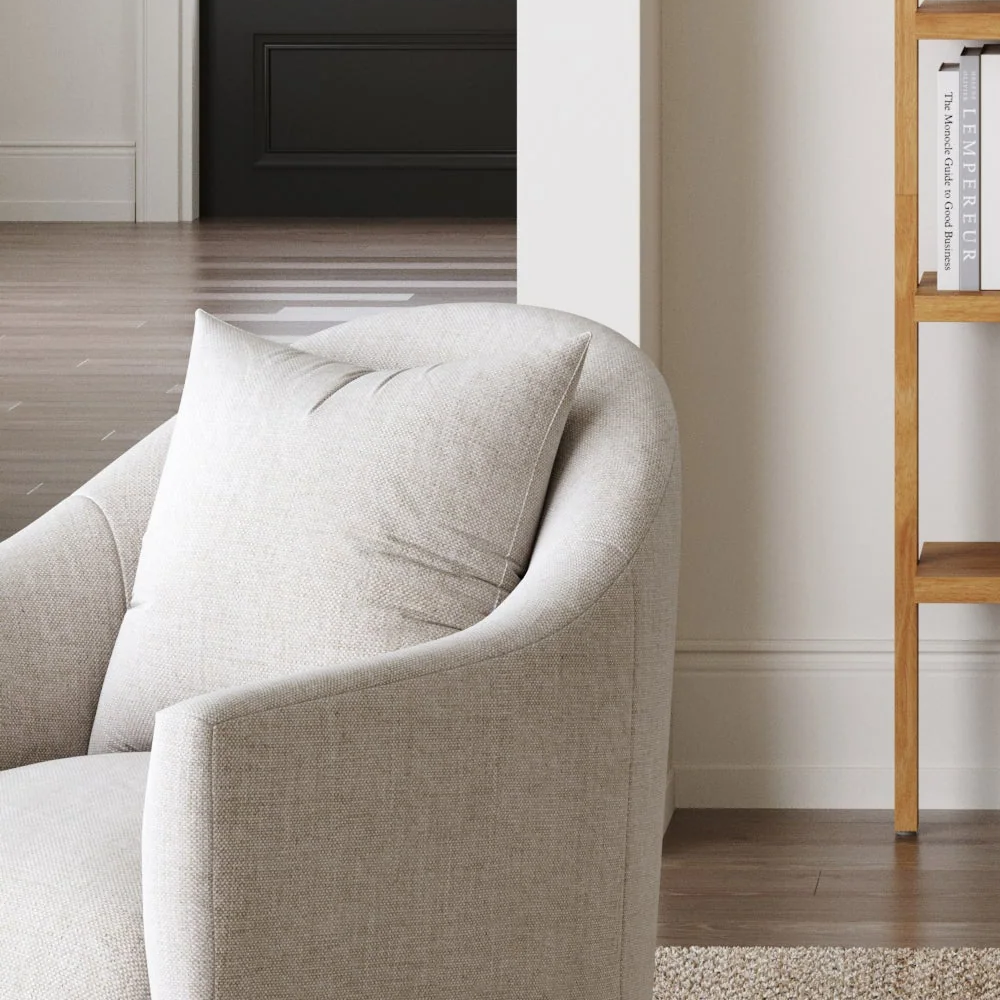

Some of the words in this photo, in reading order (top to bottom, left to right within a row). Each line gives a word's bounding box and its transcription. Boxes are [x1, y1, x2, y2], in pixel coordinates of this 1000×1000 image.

[944, 91, 953, 111] The
[944, 114, 953, 156] Monocle
[944, 157, 954, 186] Guide
[962, 108, 977, 262] LEMPEREUR
[944, 189, 951, 199] to
[944, 201, 954, 228] Good
[944, 231, 953, 271] Business
